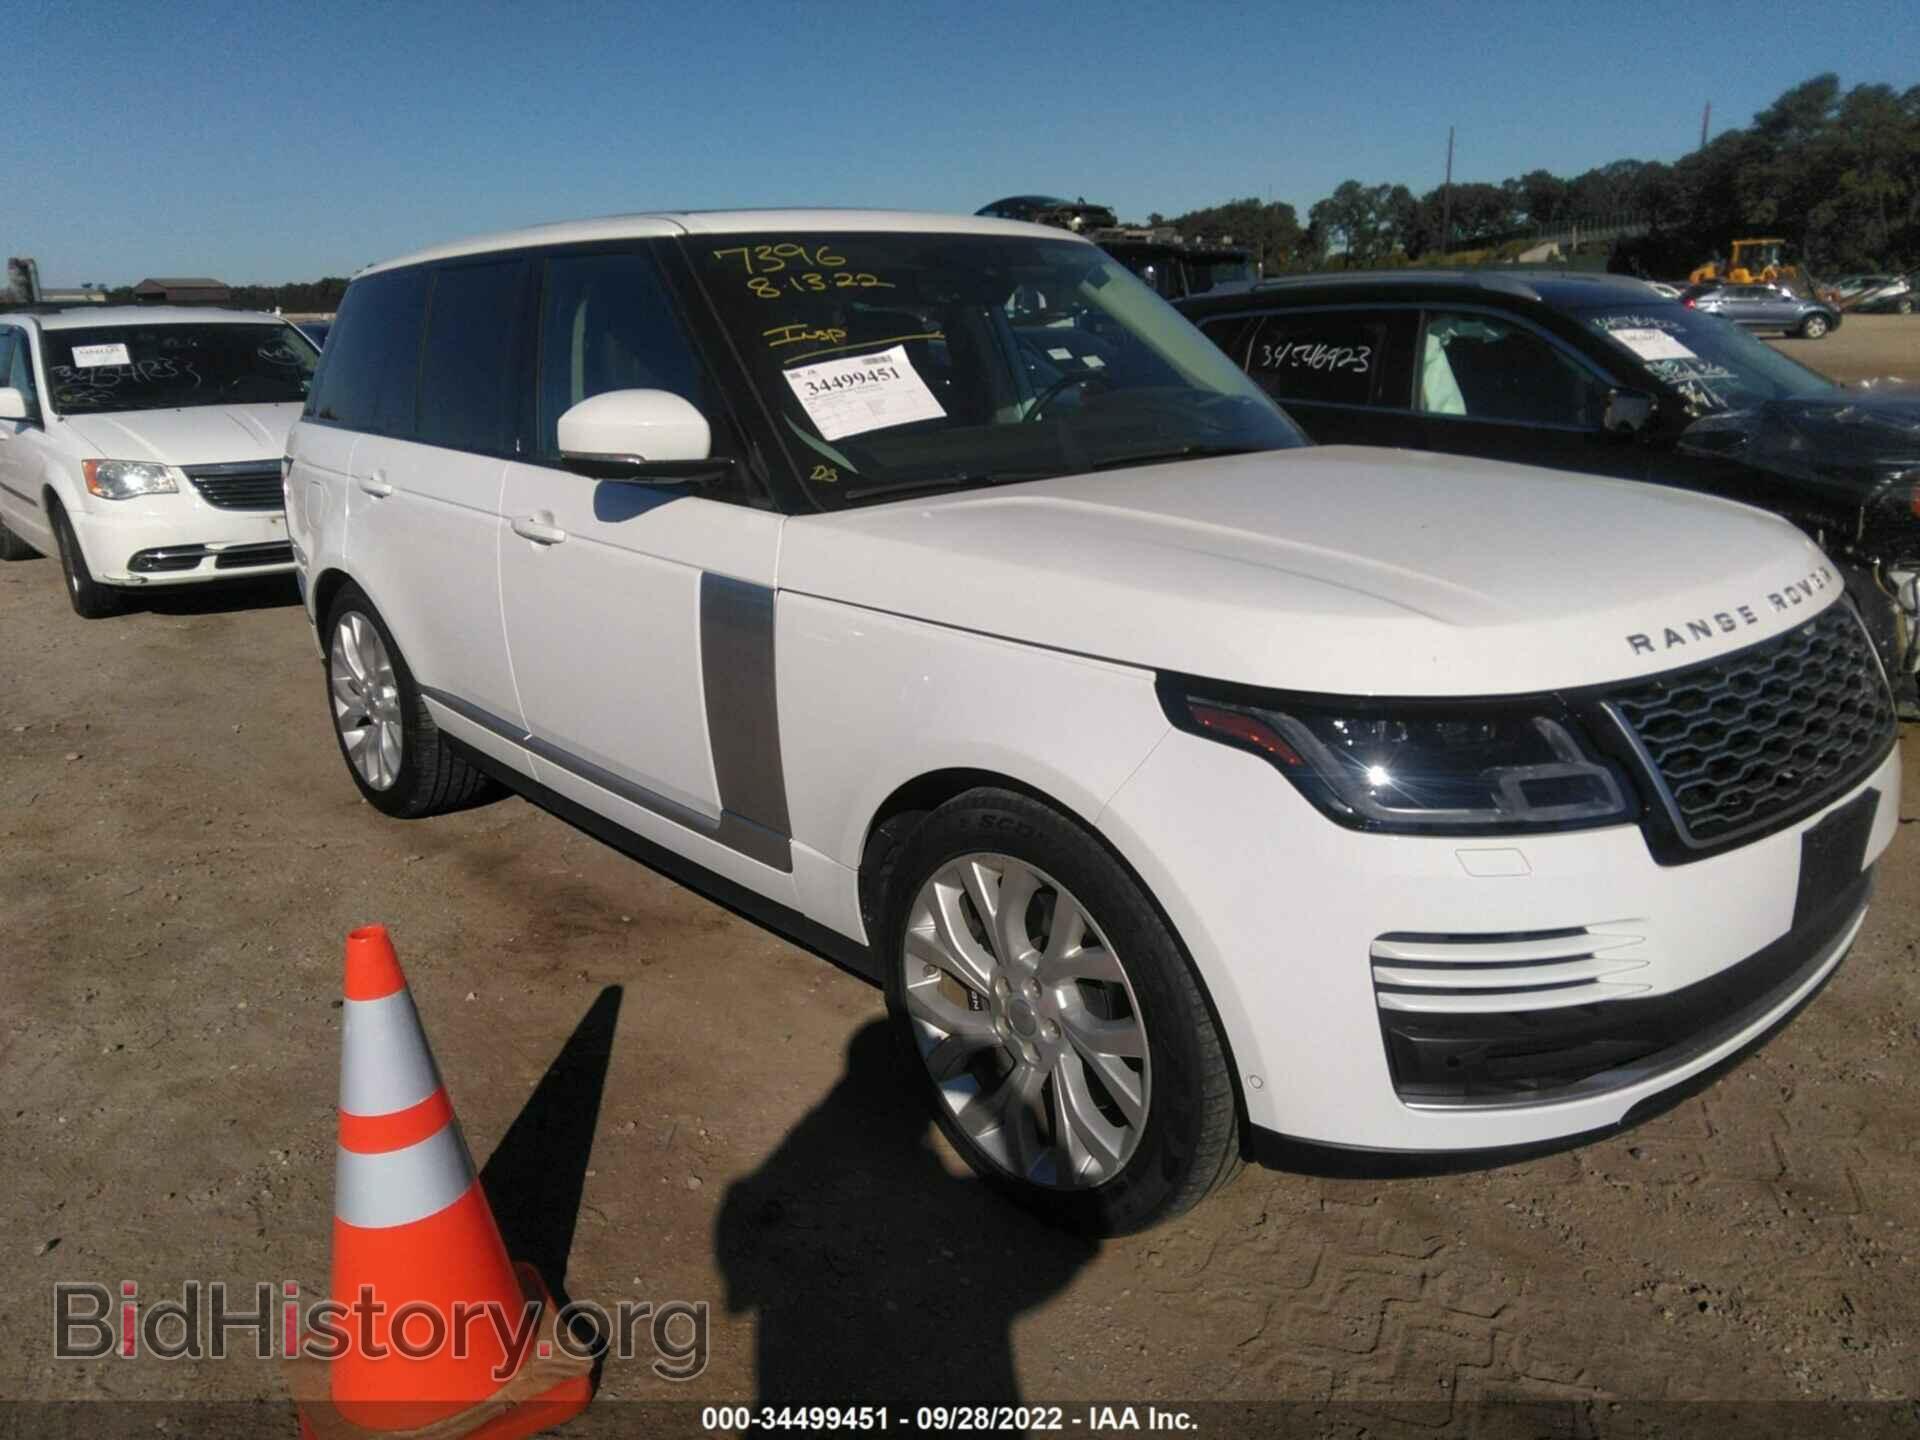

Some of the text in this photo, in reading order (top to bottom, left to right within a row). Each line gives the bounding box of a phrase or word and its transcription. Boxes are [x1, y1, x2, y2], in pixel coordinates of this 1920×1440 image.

[1262, 342, 1371, 372] 34546923
[804, 366, 901, 396] 34499451
[1625, 566, 1833, 654] RANGE ROVER
